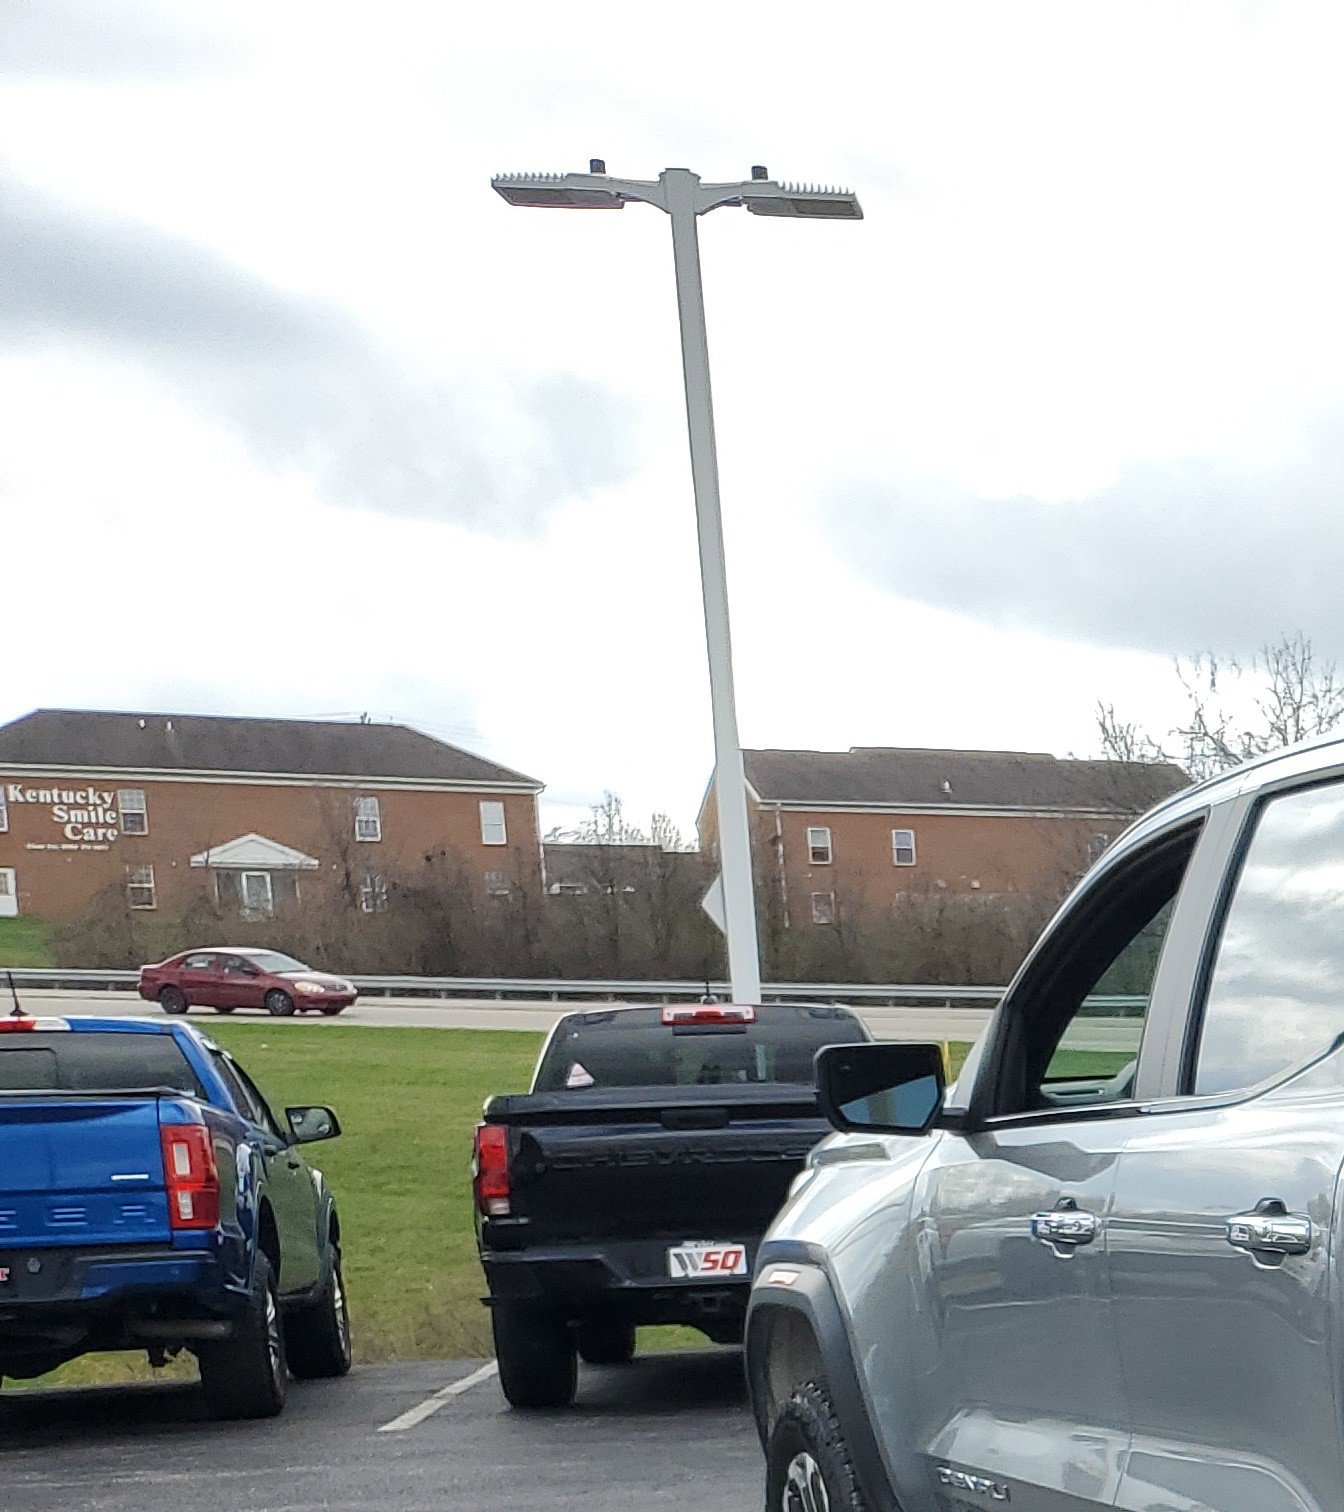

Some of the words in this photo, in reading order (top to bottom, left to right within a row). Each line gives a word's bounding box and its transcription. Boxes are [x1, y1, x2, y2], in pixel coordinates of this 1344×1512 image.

[8, 784, 115, 809] Kentucky
[52, 805, 117, 824] Smile
[64, 823, 119, 841] Care
